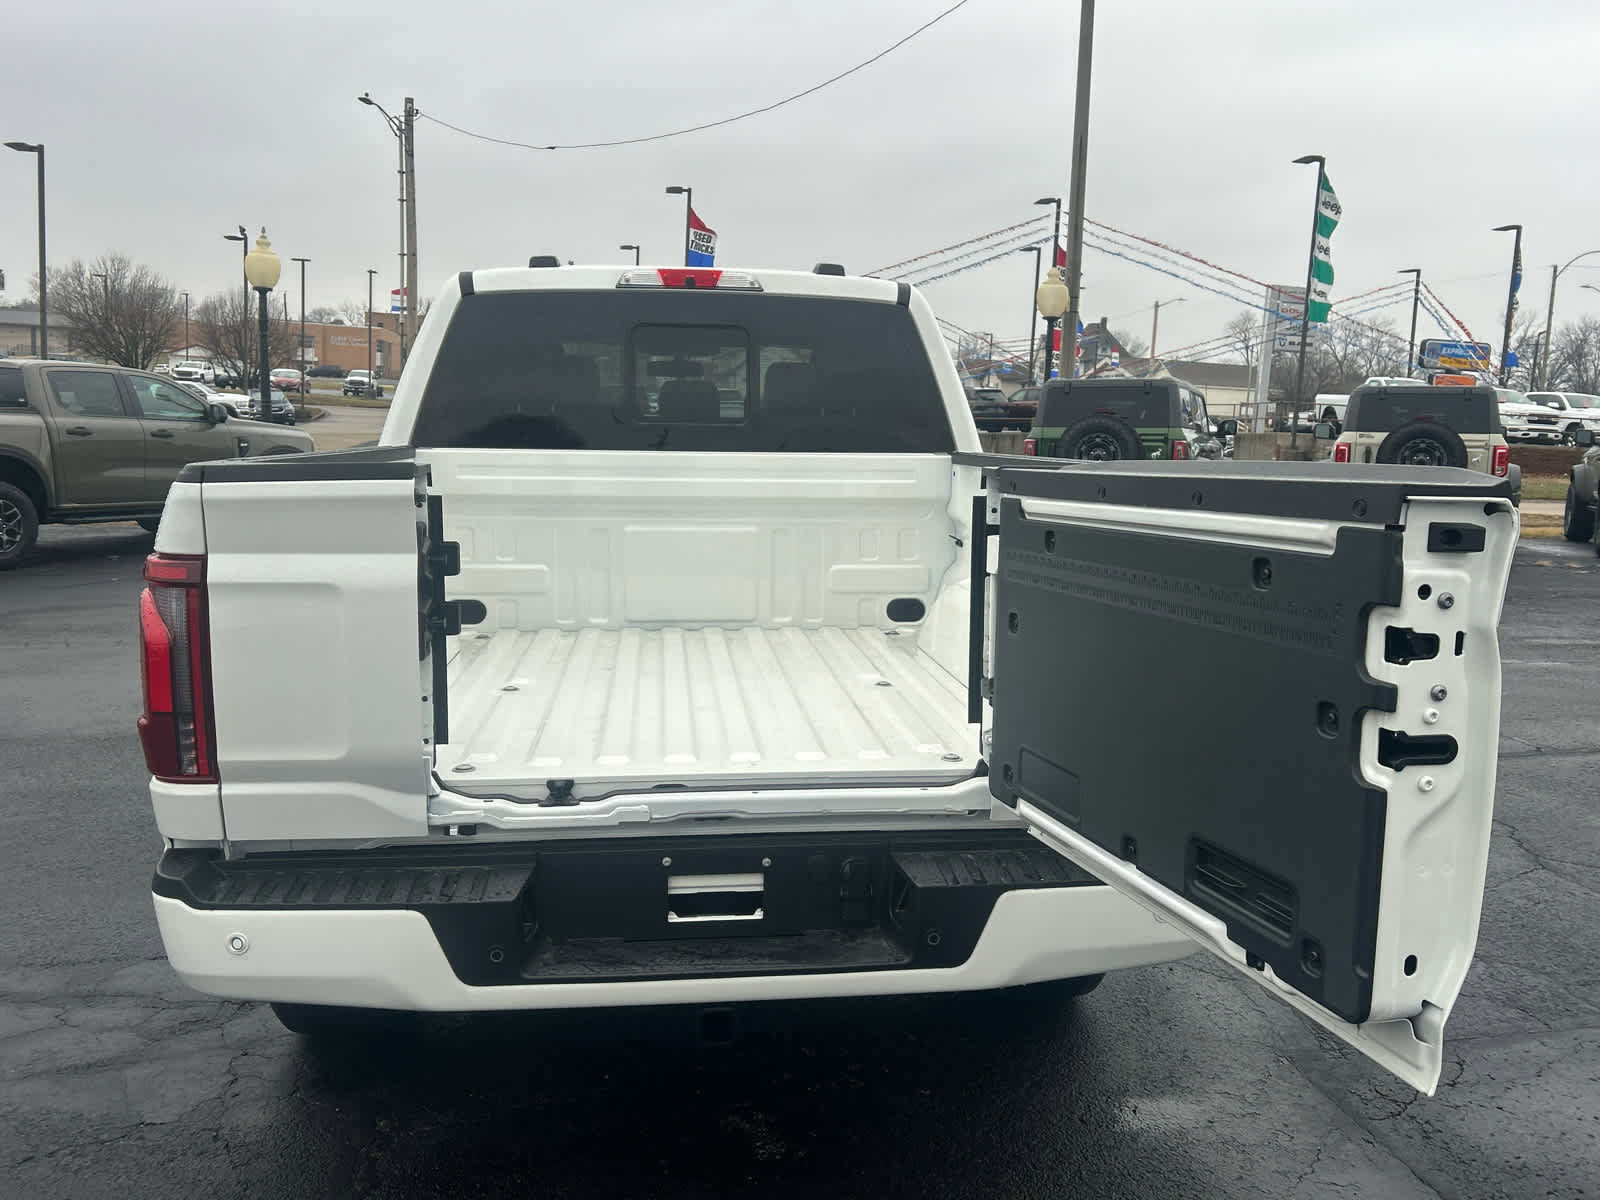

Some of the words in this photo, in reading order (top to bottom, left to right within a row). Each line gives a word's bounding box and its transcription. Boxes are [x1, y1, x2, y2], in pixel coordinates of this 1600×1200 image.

[693, 231, 713, 244] USED
[690, 240, 714, 255] TRUCKS
[1317, 241, 1331, 257] Jee
